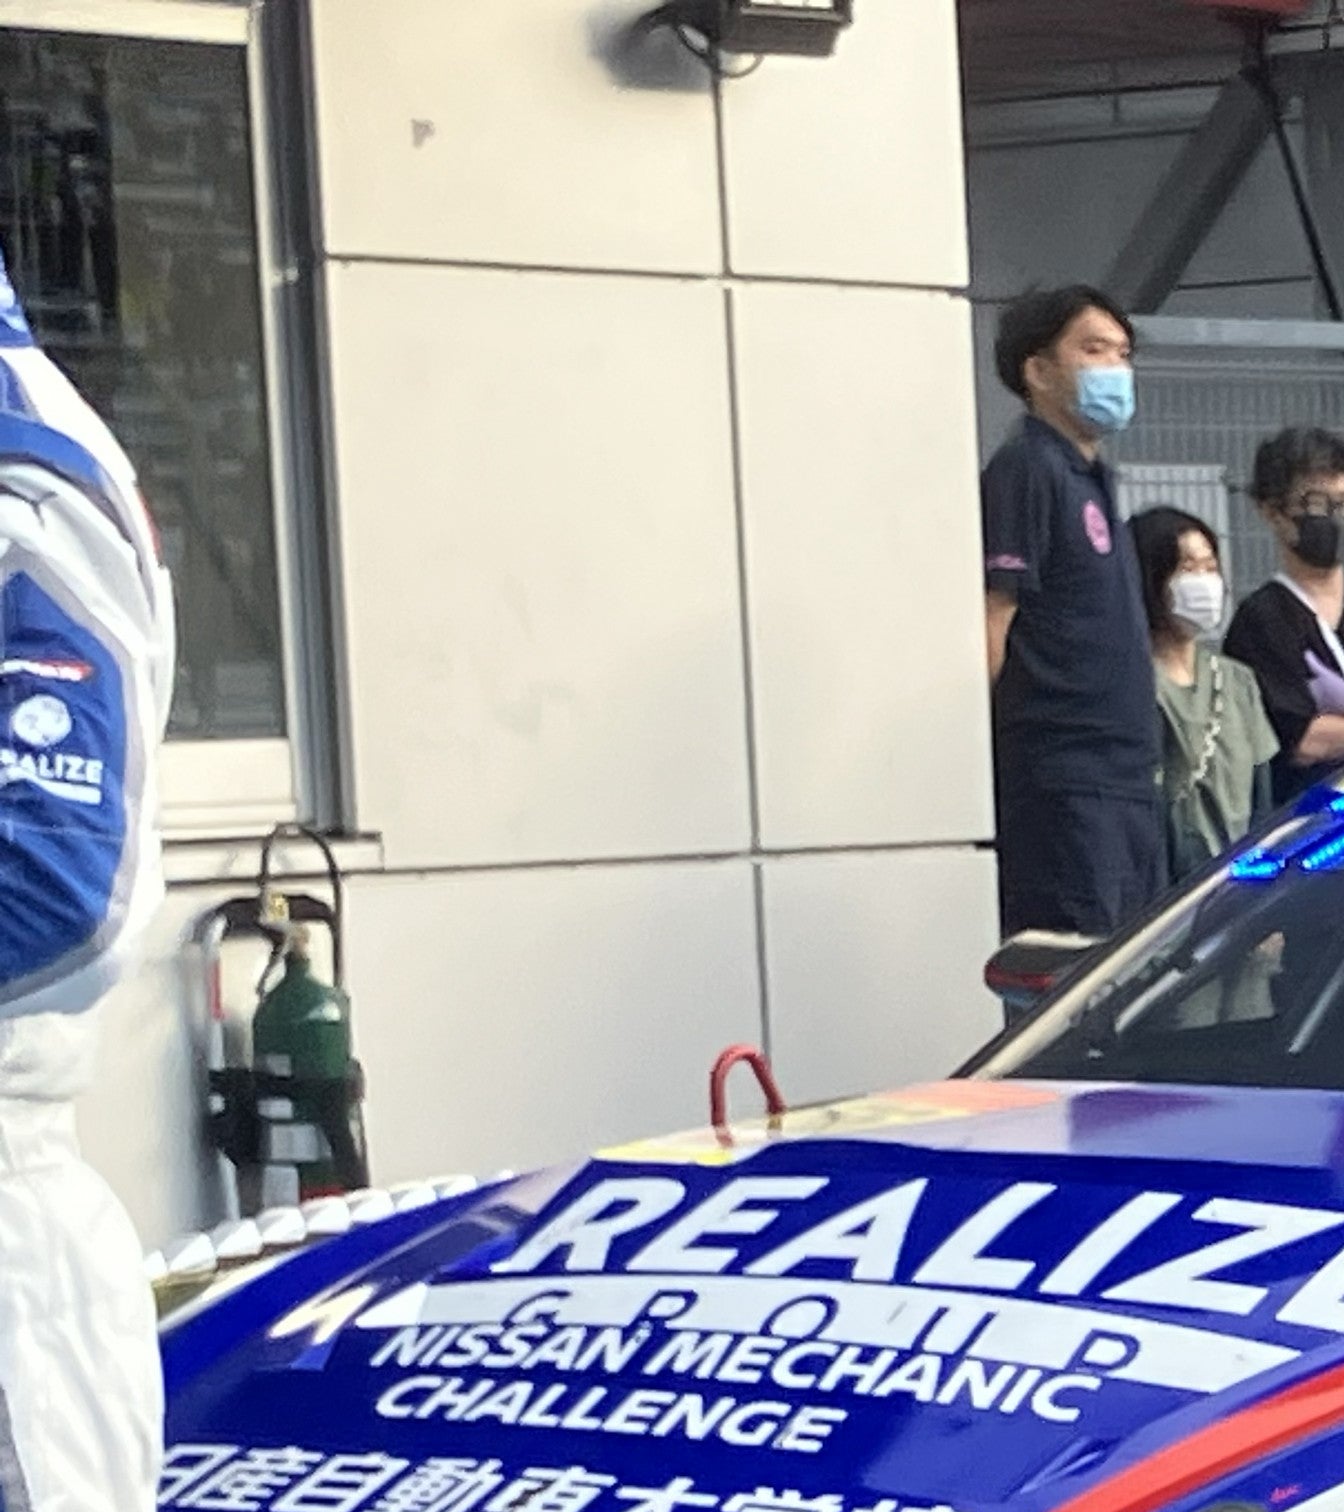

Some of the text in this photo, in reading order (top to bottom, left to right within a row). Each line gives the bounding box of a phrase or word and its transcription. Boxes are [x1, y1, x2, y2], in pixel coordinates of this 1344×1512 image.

[371, 1322, 1103, 1422] NISSAN MECHANIC
[375, 1374, 848, 1452] CHALLENGE
